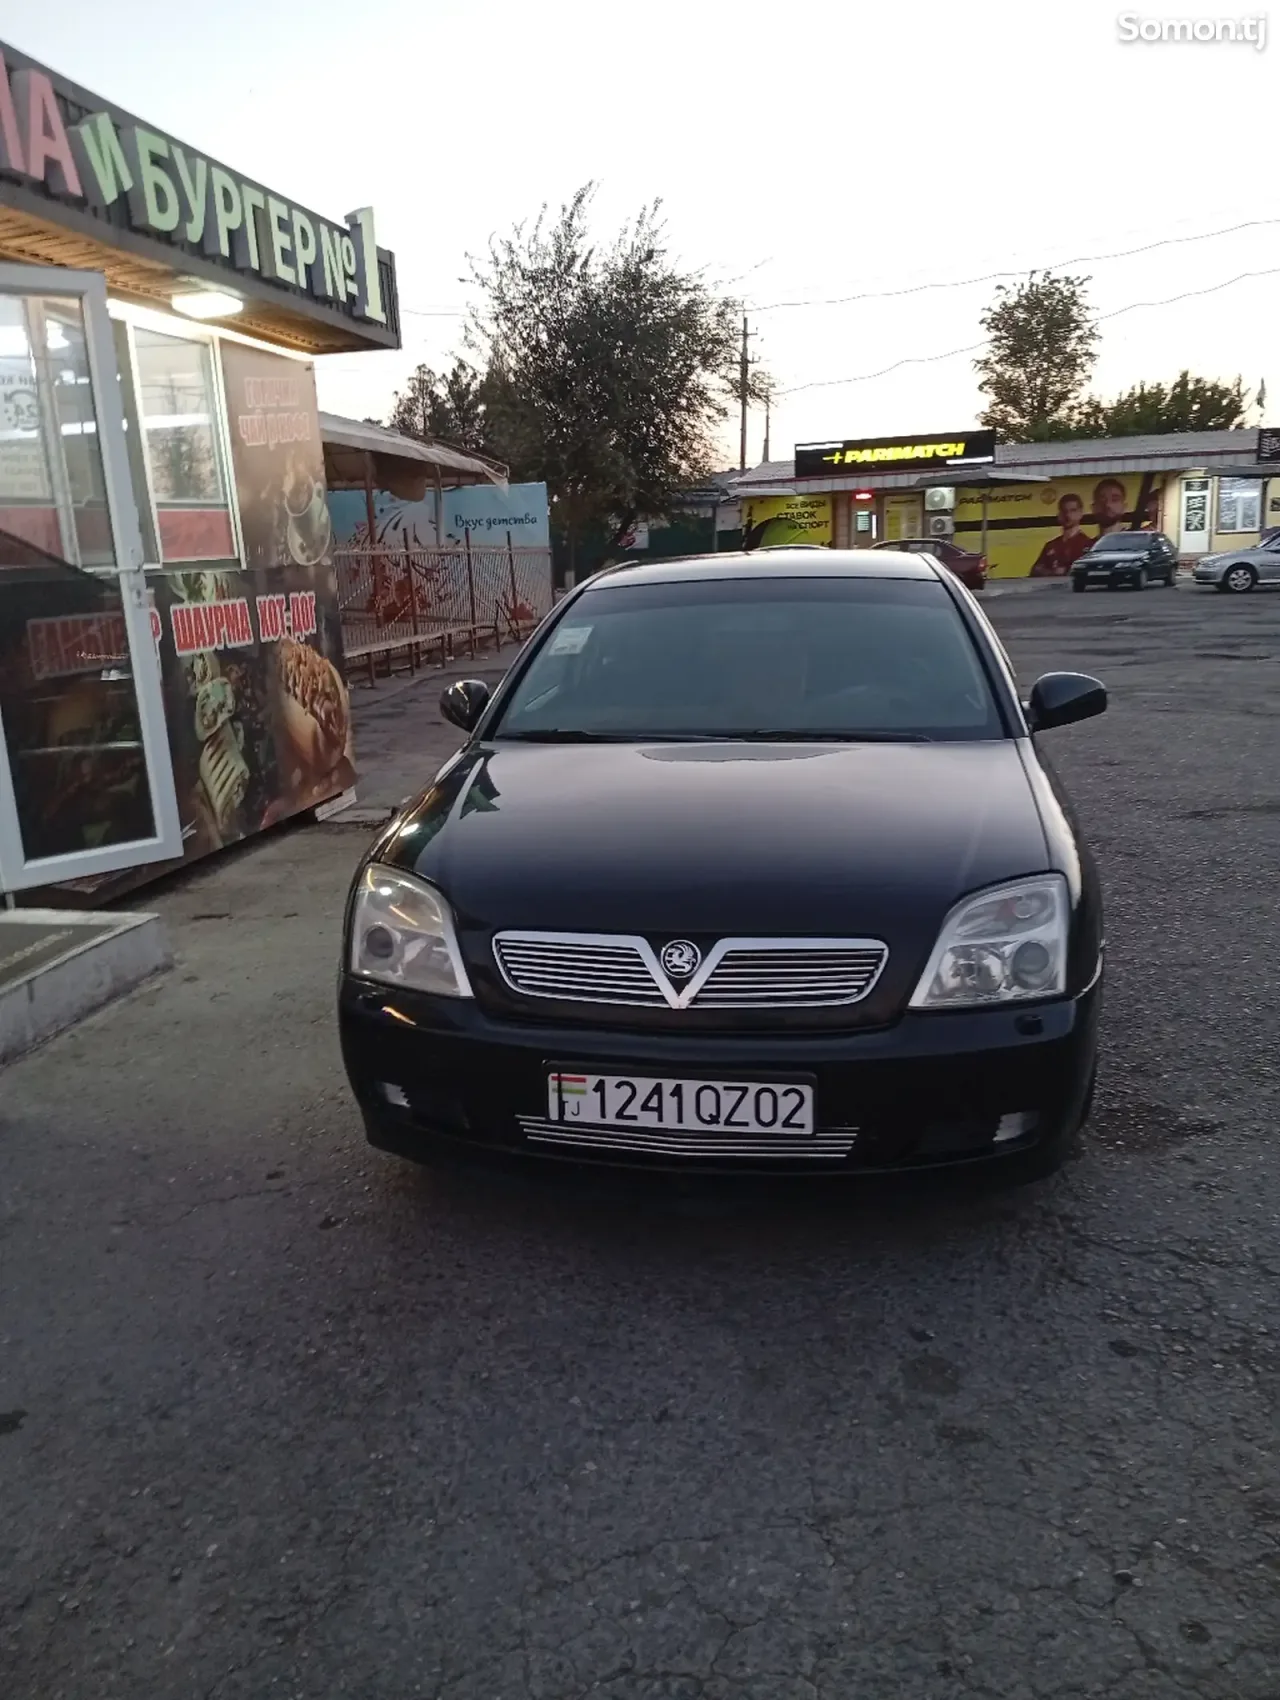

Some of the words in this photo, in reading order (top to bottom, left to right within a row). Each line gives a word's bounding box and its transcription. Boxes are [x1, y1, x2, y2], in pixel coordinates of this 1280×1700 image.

[134, 126, 316, 290] БУРГЕР
[844, 442, 966, 464] PARIMATCH
[959, 492, 1033, 505] PARMATCH
[454, 514, 485, 531] Вкус
[485, 512, 538, 531] детства
[776, 511, 818, 520] СТАВОК
[799, 520, 830, 530] СПОРТ
[171, 598, 253, 656] ШАУРМА
[256, 591, 316, 643] ХОТ-ДОГ
[592, 1078, 805, 1129] 1241QZ02
